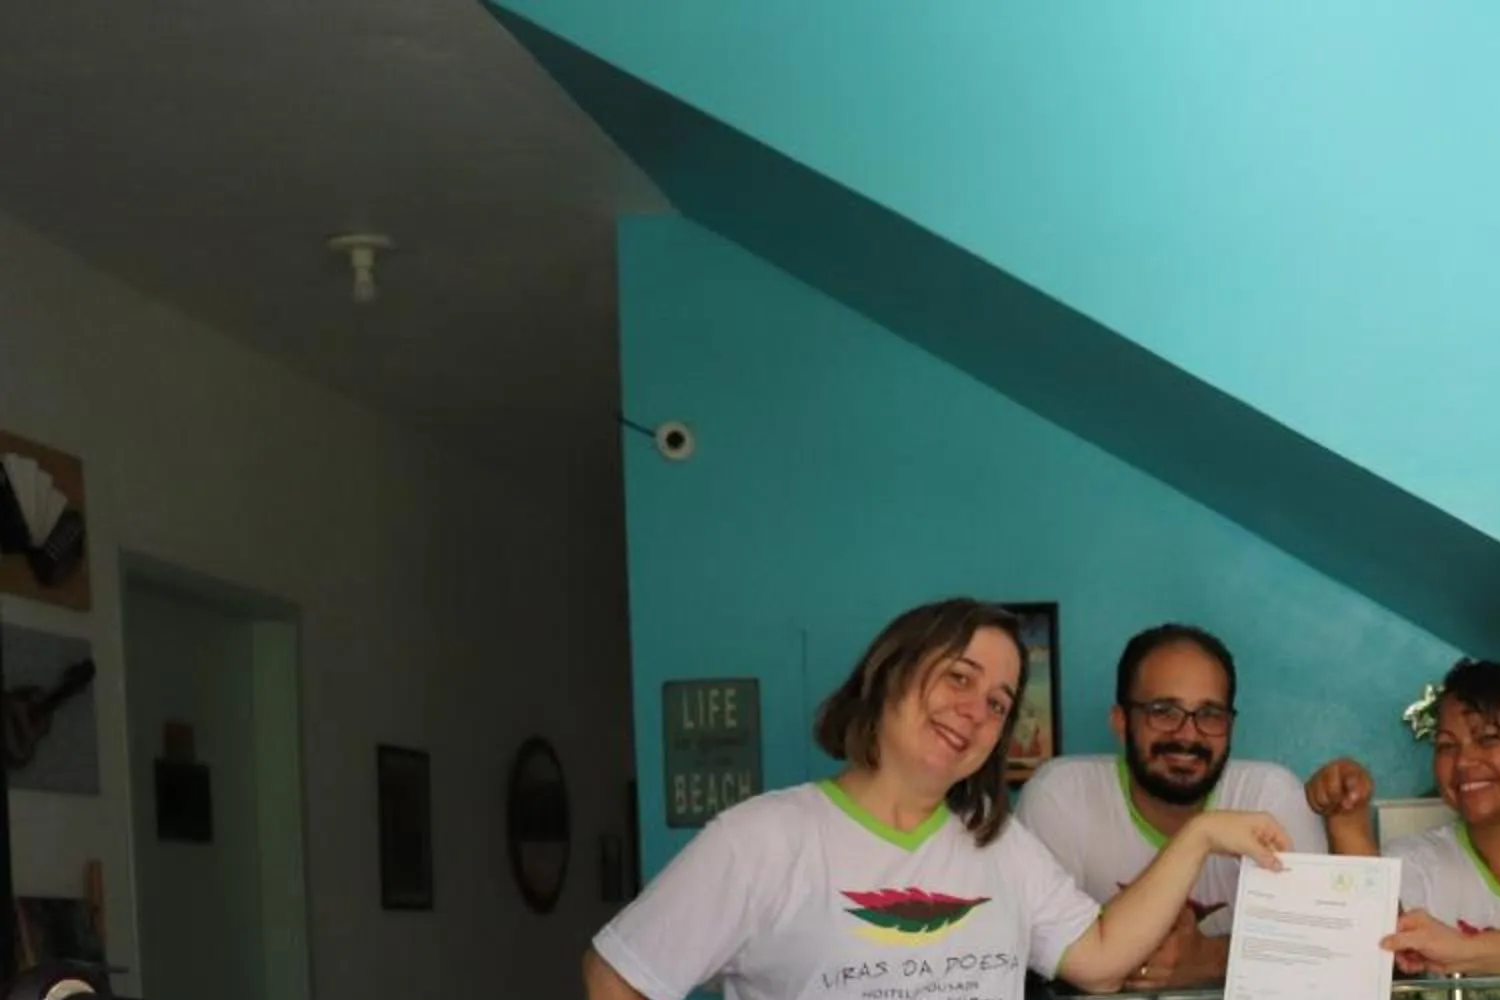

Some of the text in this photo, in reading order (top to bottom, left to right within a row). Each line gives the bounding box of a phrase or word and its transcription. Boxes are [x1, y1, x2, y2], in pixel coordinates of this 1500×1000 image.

[682, 687, 738, 730] LIFE
[673, 770, 753, 815] BEACH
[902, 959, 932, 977] DA
